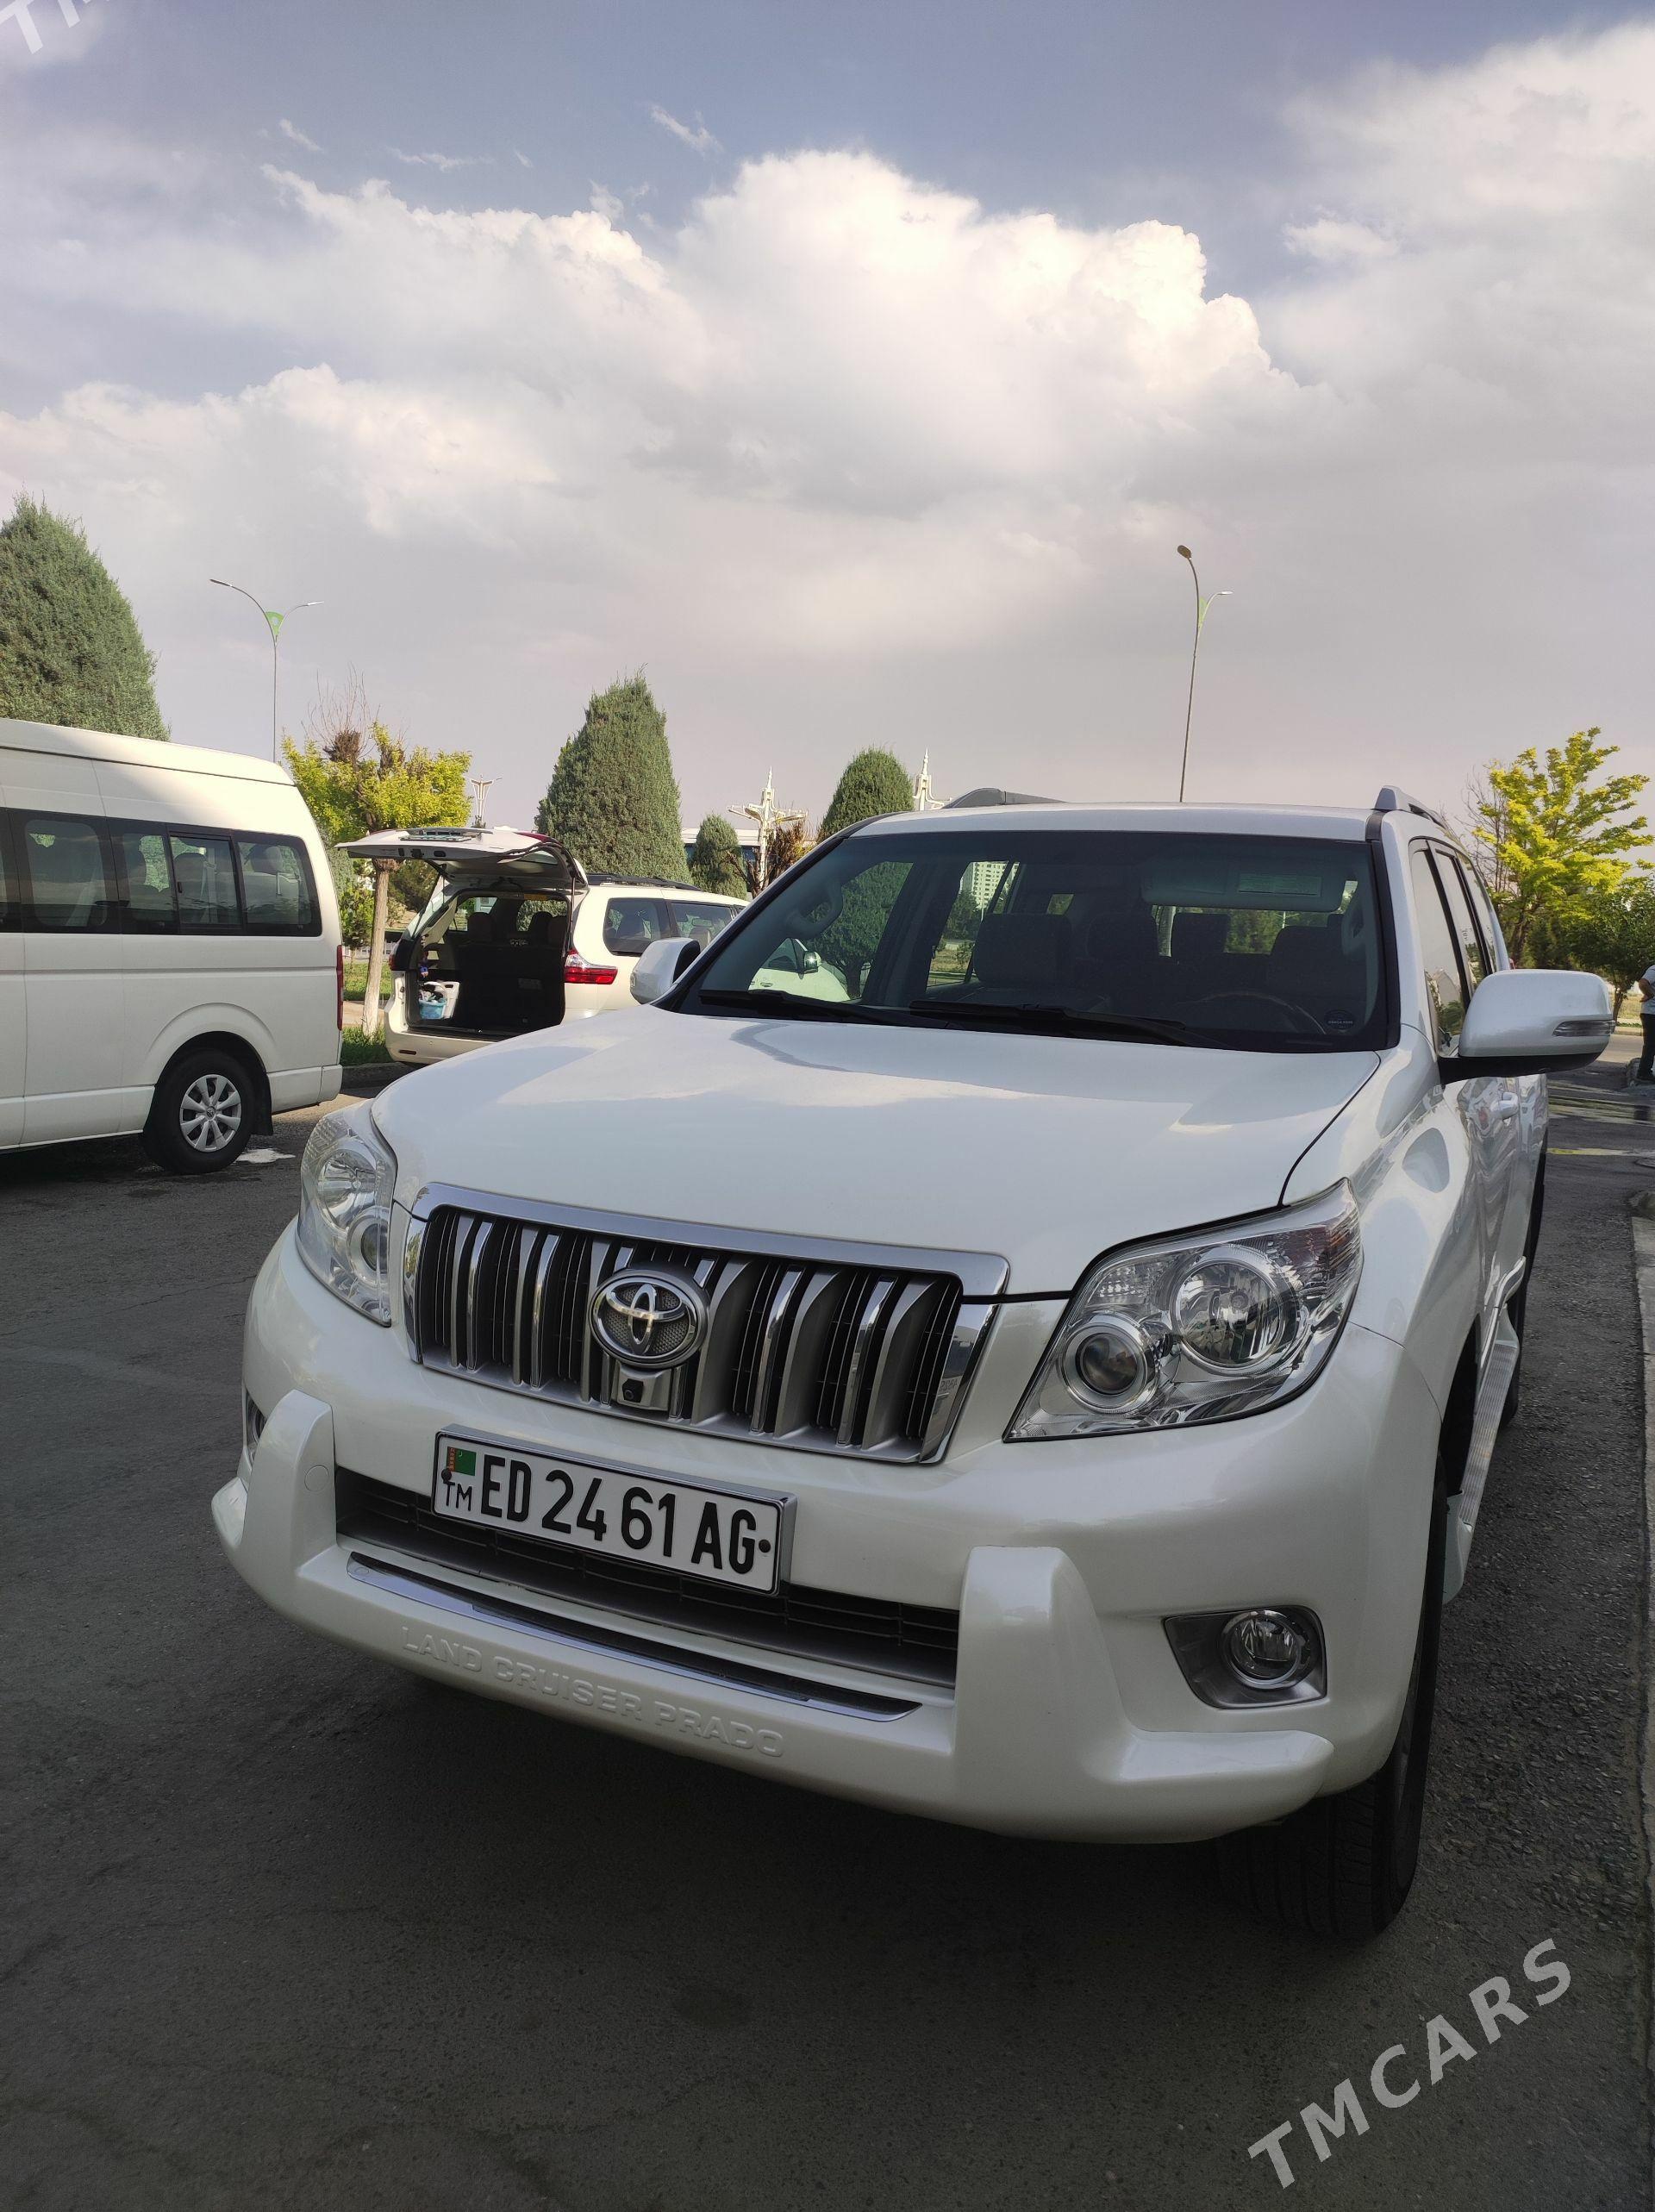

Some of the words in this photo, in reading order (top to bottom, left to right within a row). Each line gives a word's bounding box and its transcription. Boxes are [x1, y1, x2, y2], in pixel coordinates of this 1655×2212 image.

[442, 1480, 473, 1512] TM
[480, 1453, 532, 1522] ED
[690, 1501, 757, 1574] AG
[401, 1626, 483, 1672] LAND
[492, 1655, 642, 1721] CRUISER
[653, 1700, 784, 1758] PRADO
